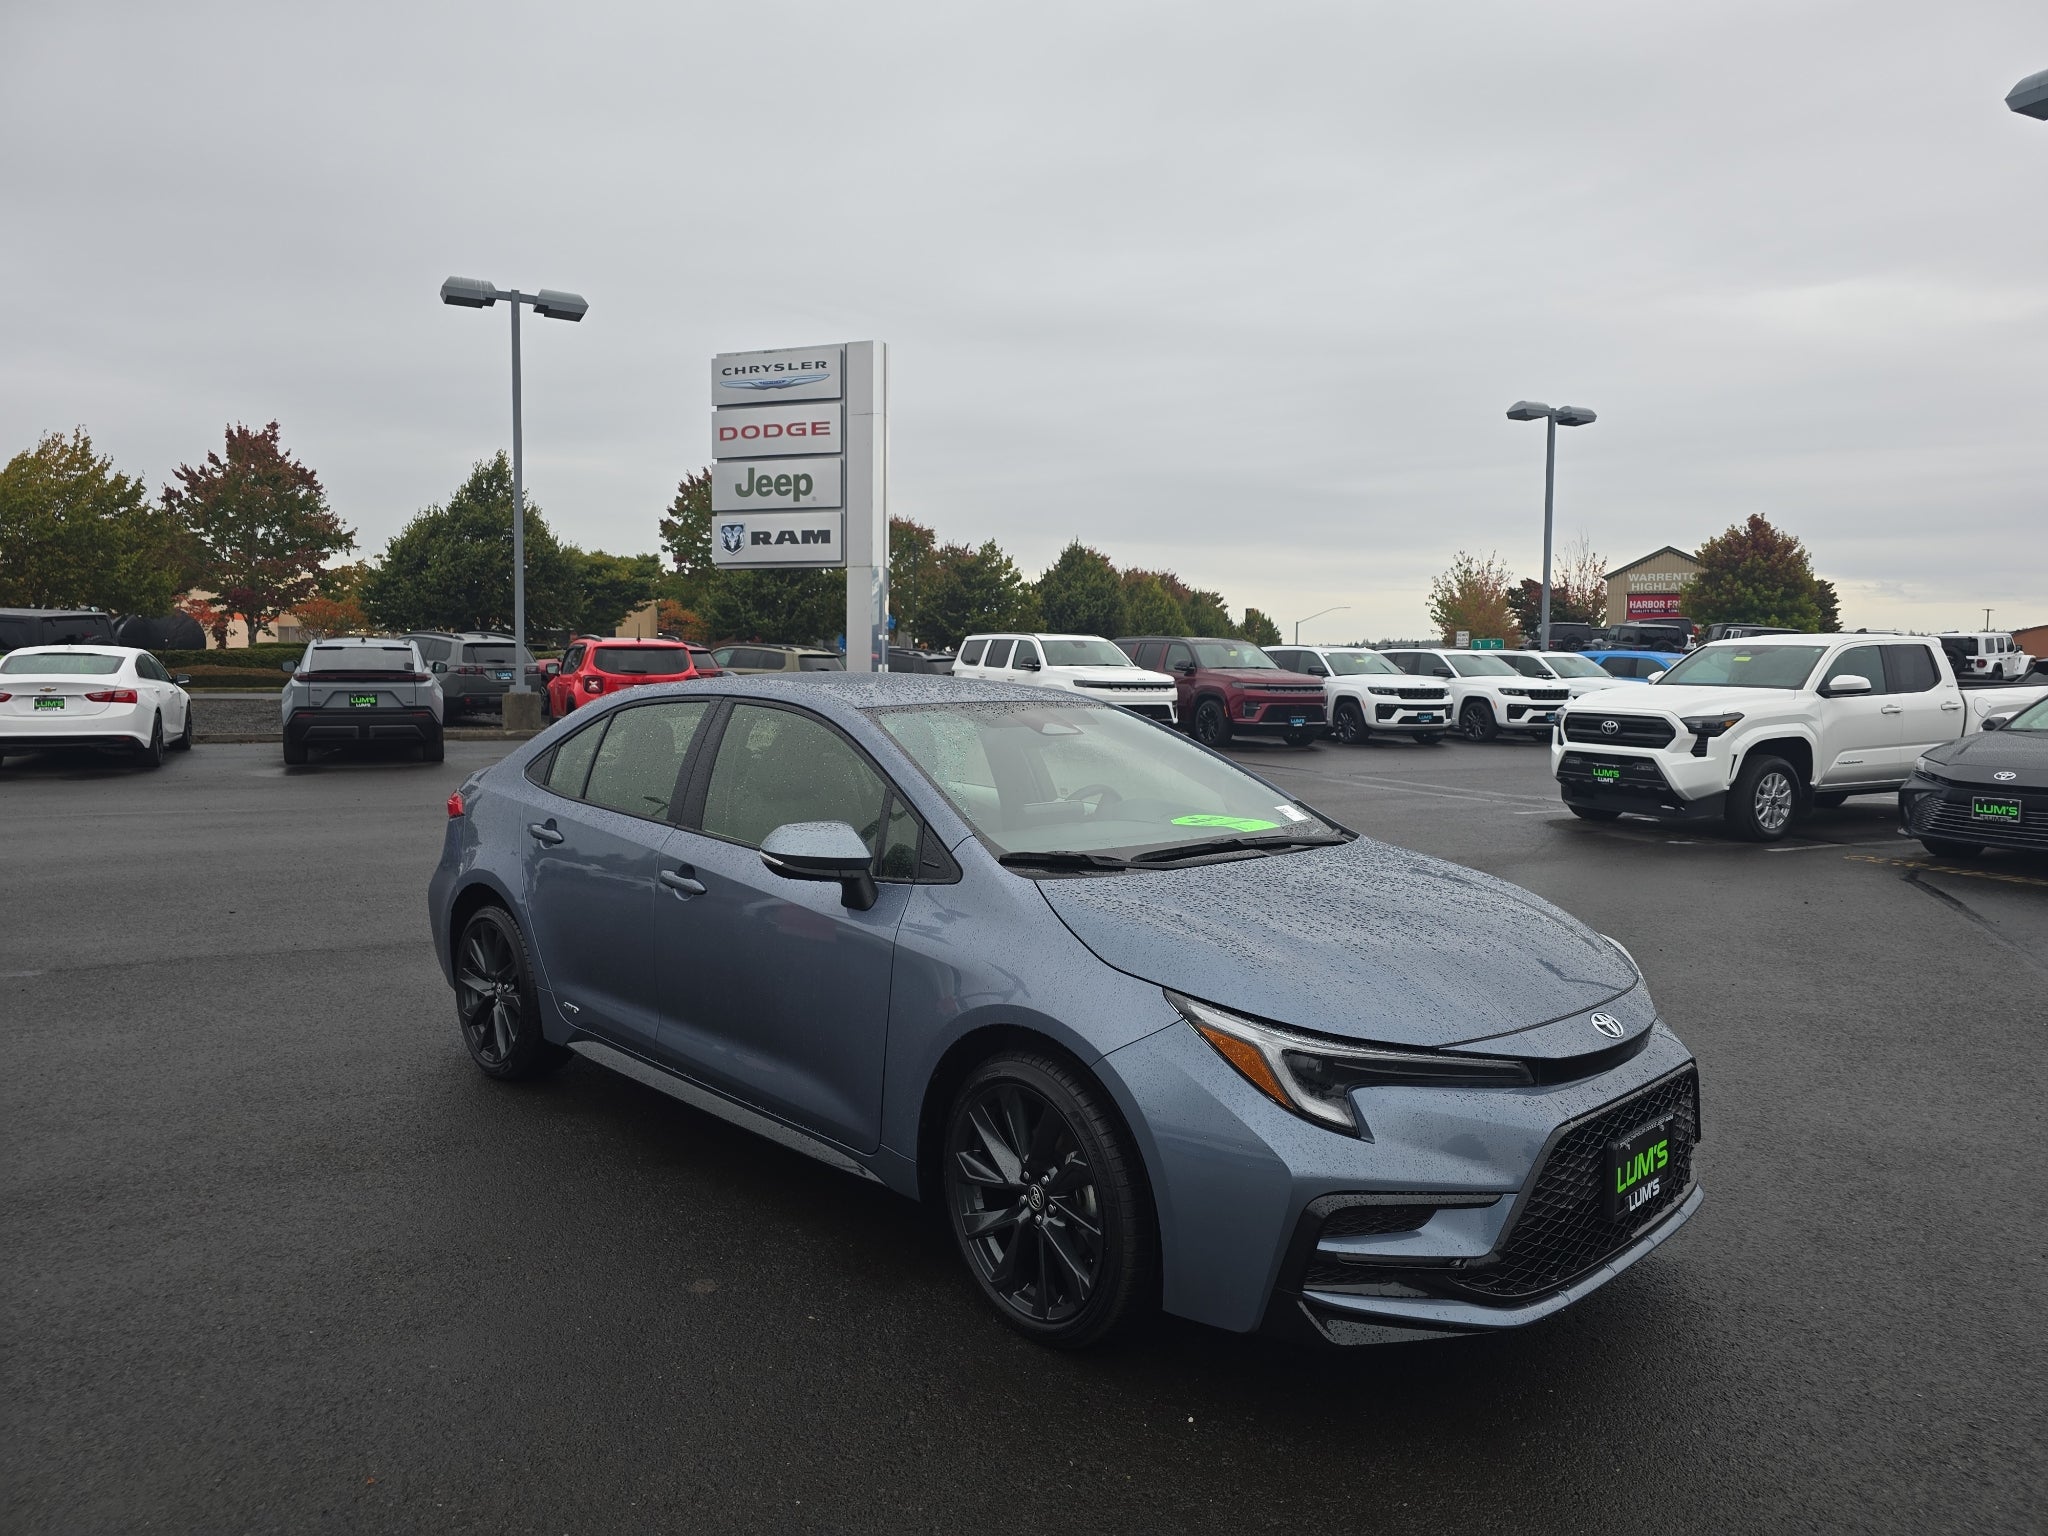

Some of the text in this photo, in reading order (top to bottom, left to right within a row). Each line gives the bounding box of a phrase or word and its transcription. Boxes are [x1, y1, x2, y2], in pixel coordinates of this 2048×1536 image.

[721, 360, 828, 376] CHRYSLER
[719, 421, 831, 441] DODGE
[735, 467, 814, 502] Jeep
[751, 529, 831, 546] RAM
[1630, 600, 1665, 609] HARBOR
[350, 696, 376, 704] LUM'S
[1593, 768, 1620, 778] LUM'S
[1975, 803, 2018, 816] LUM'S
[1617, 1139, 1668, 1194] LUM'S
[1629, 1177, 1660, 1212] LUM'S
